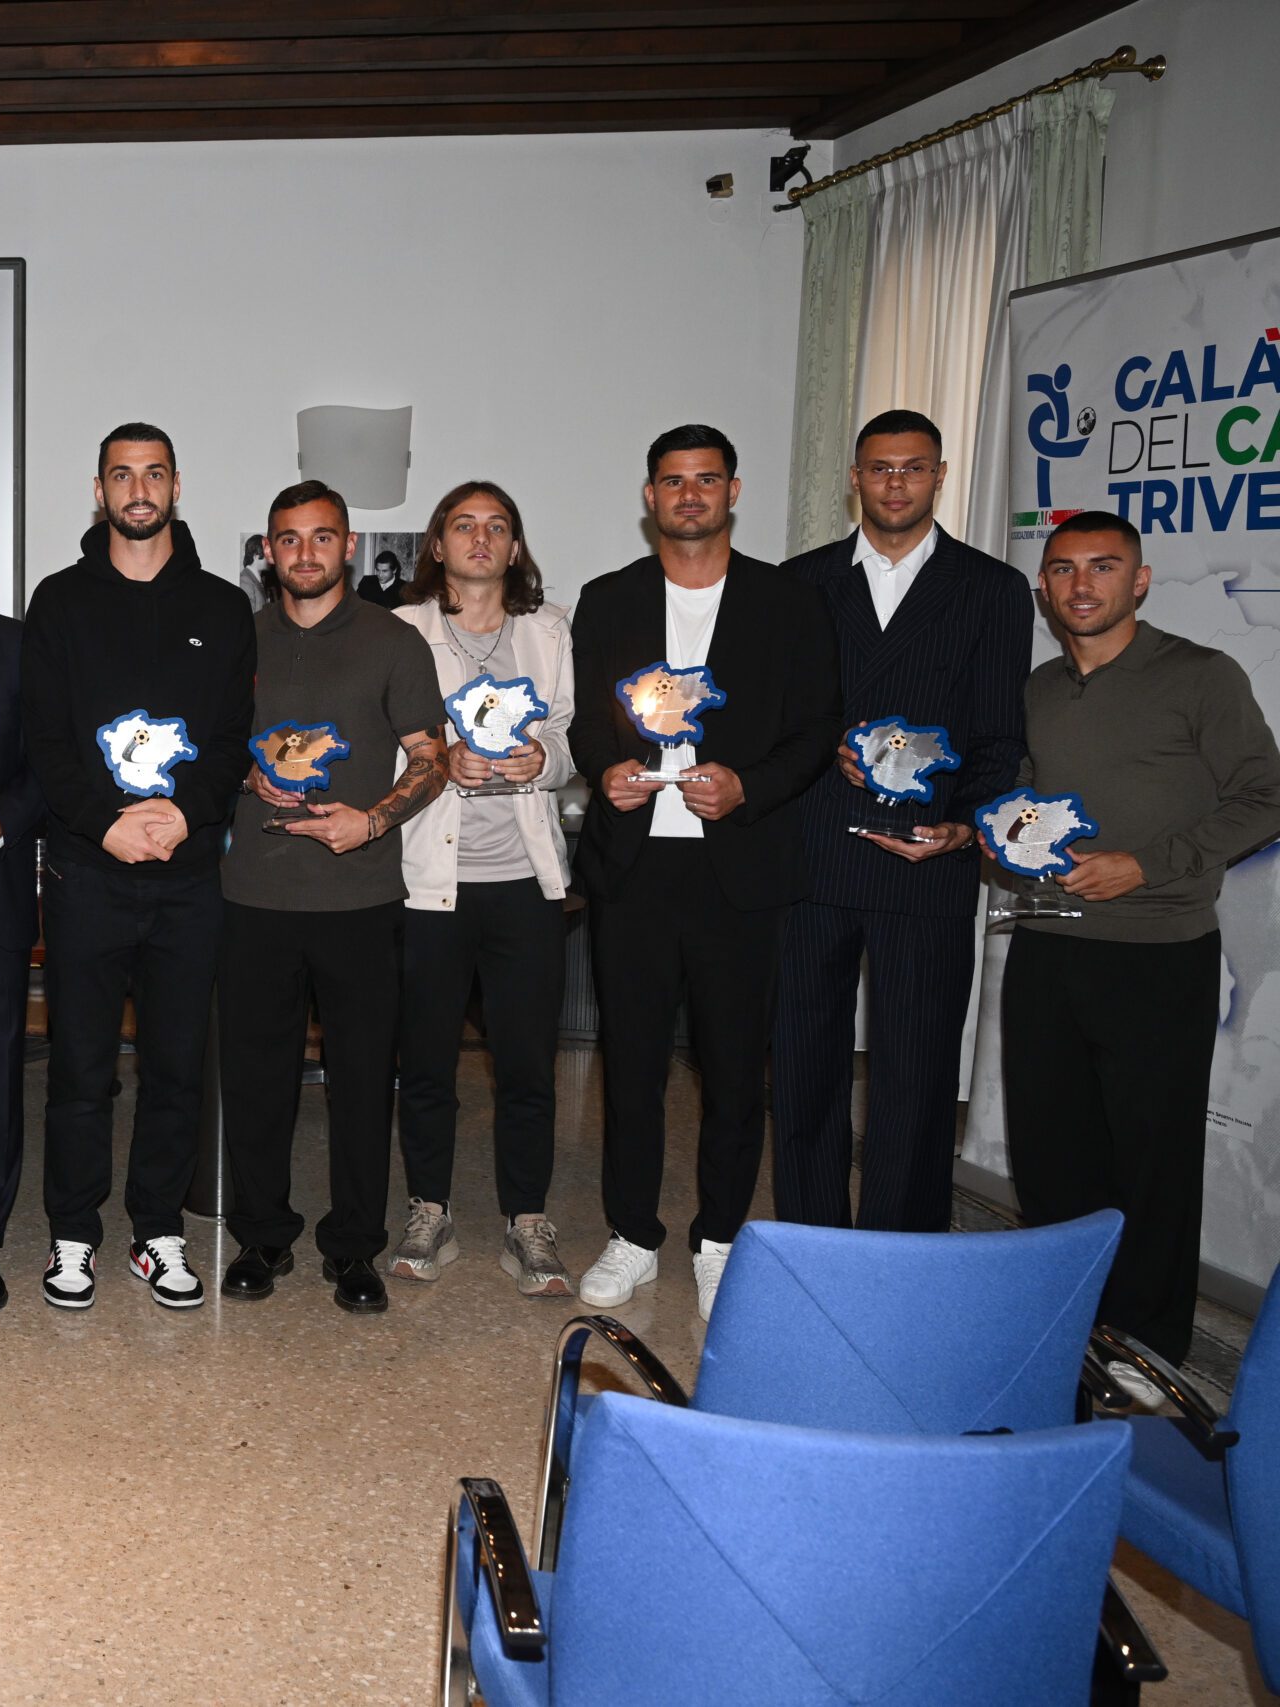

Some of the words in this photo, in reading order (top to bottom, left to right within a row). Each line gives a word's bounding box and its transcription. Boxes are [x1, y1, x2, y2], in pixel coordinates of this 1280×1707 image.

[1115, 327, 1280, 412] GALÀ
[1108, 413, 1210, 475] DEL
[1108, 471, 1280, 535] TRIVE
